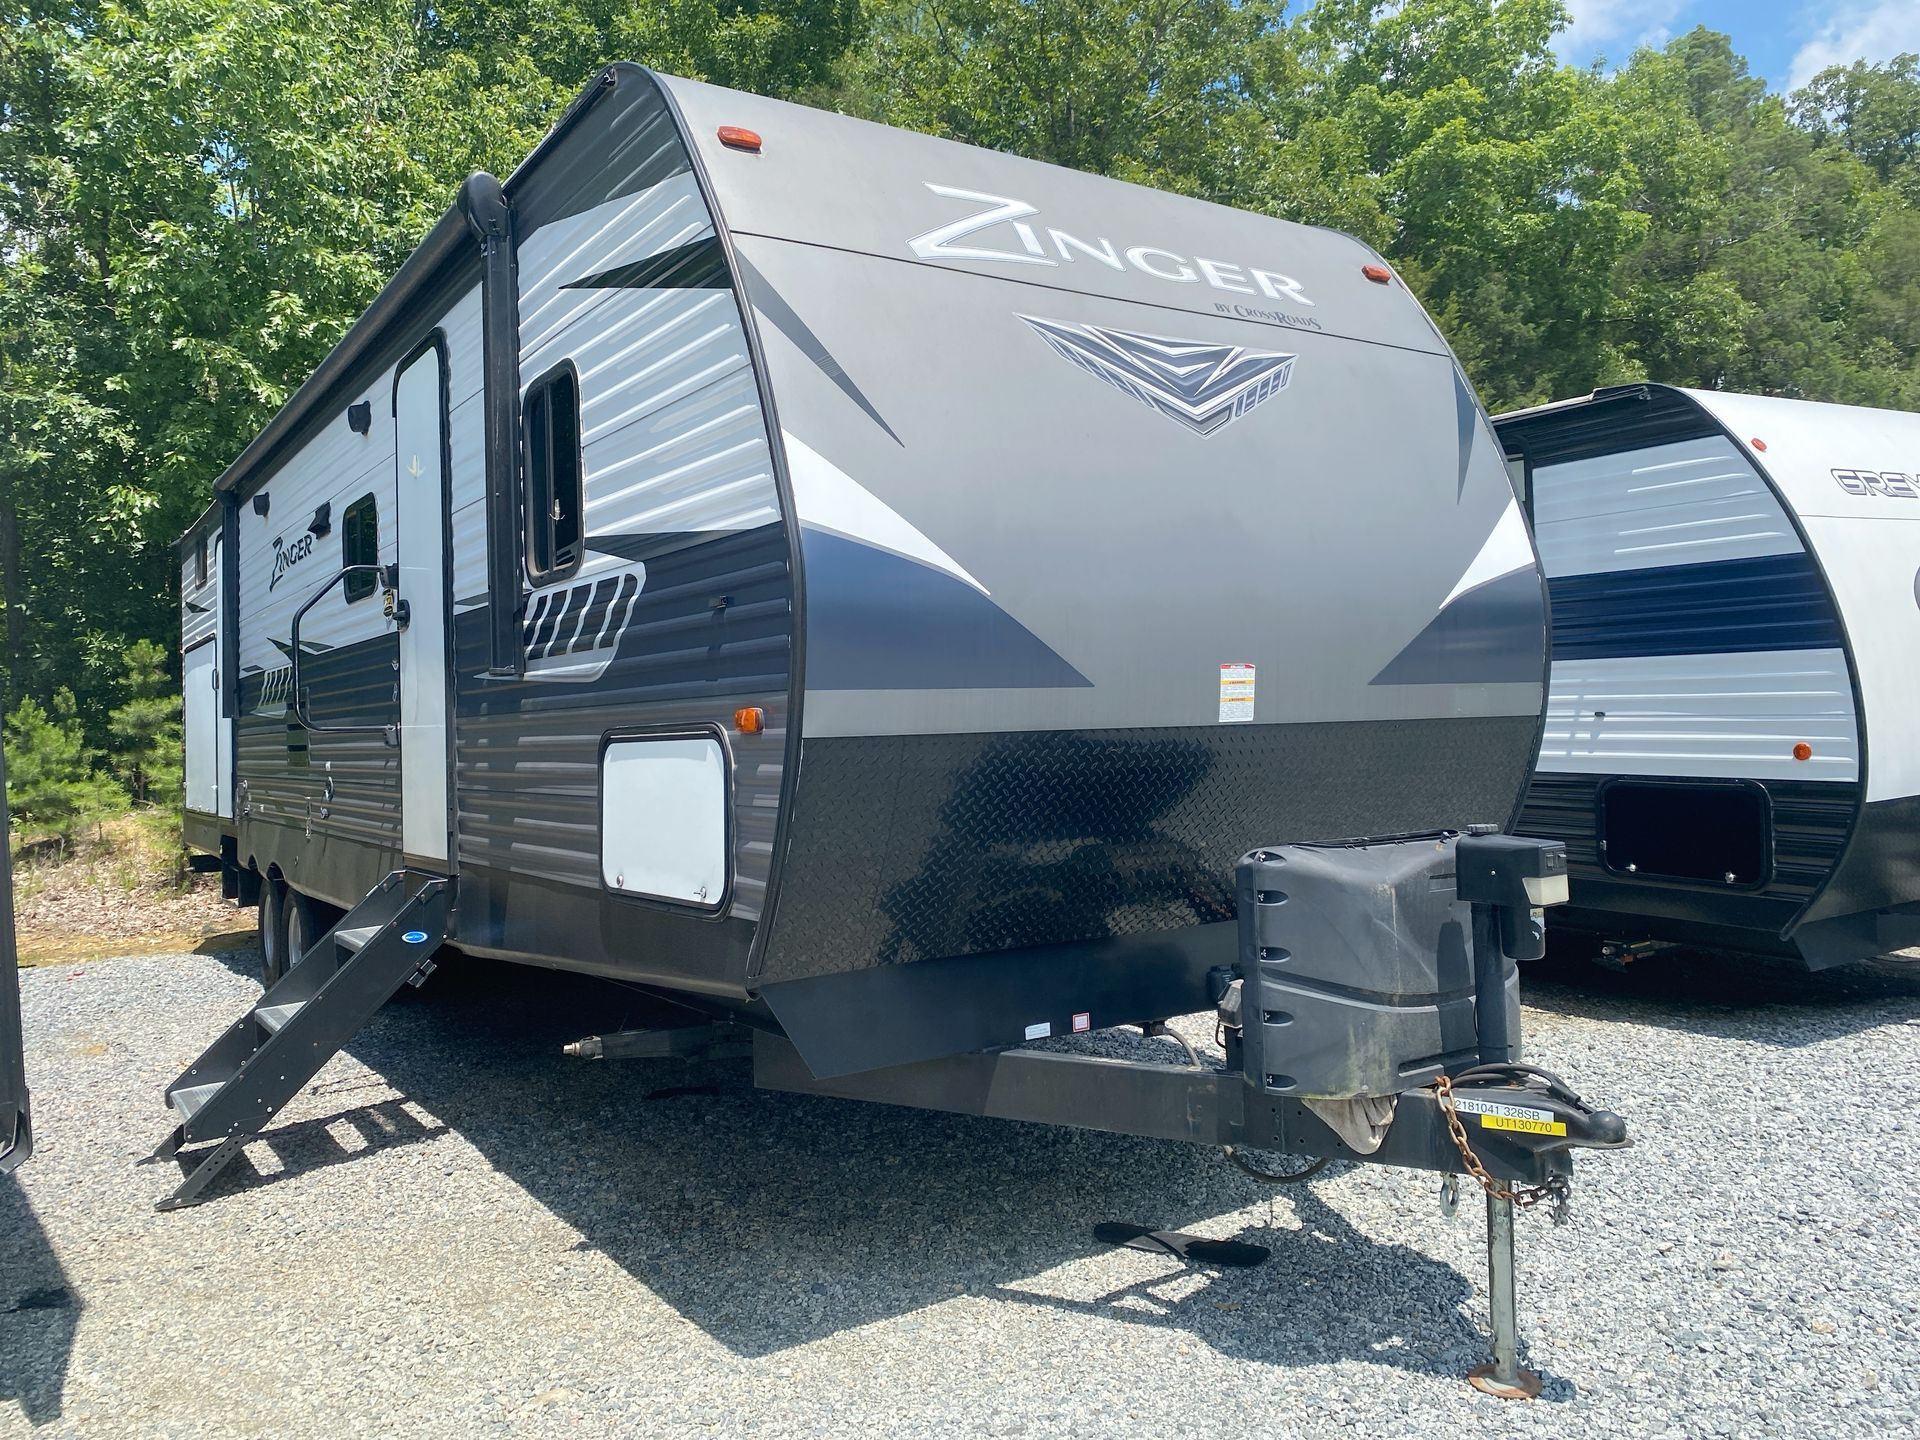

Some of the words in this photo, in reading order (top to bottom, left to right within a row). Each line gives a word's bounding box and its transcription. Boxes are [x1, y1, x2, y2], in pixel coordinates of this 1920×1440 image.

[1213, 302, 1231, 314] BY
[269, 534, 313, 593] ZINGER
[1455, 1100, 1499, 1114] 2181041
[1503, 1107, 1540, 1120] 328SB
[1496, 1118, 1552, 1132] UT130770
